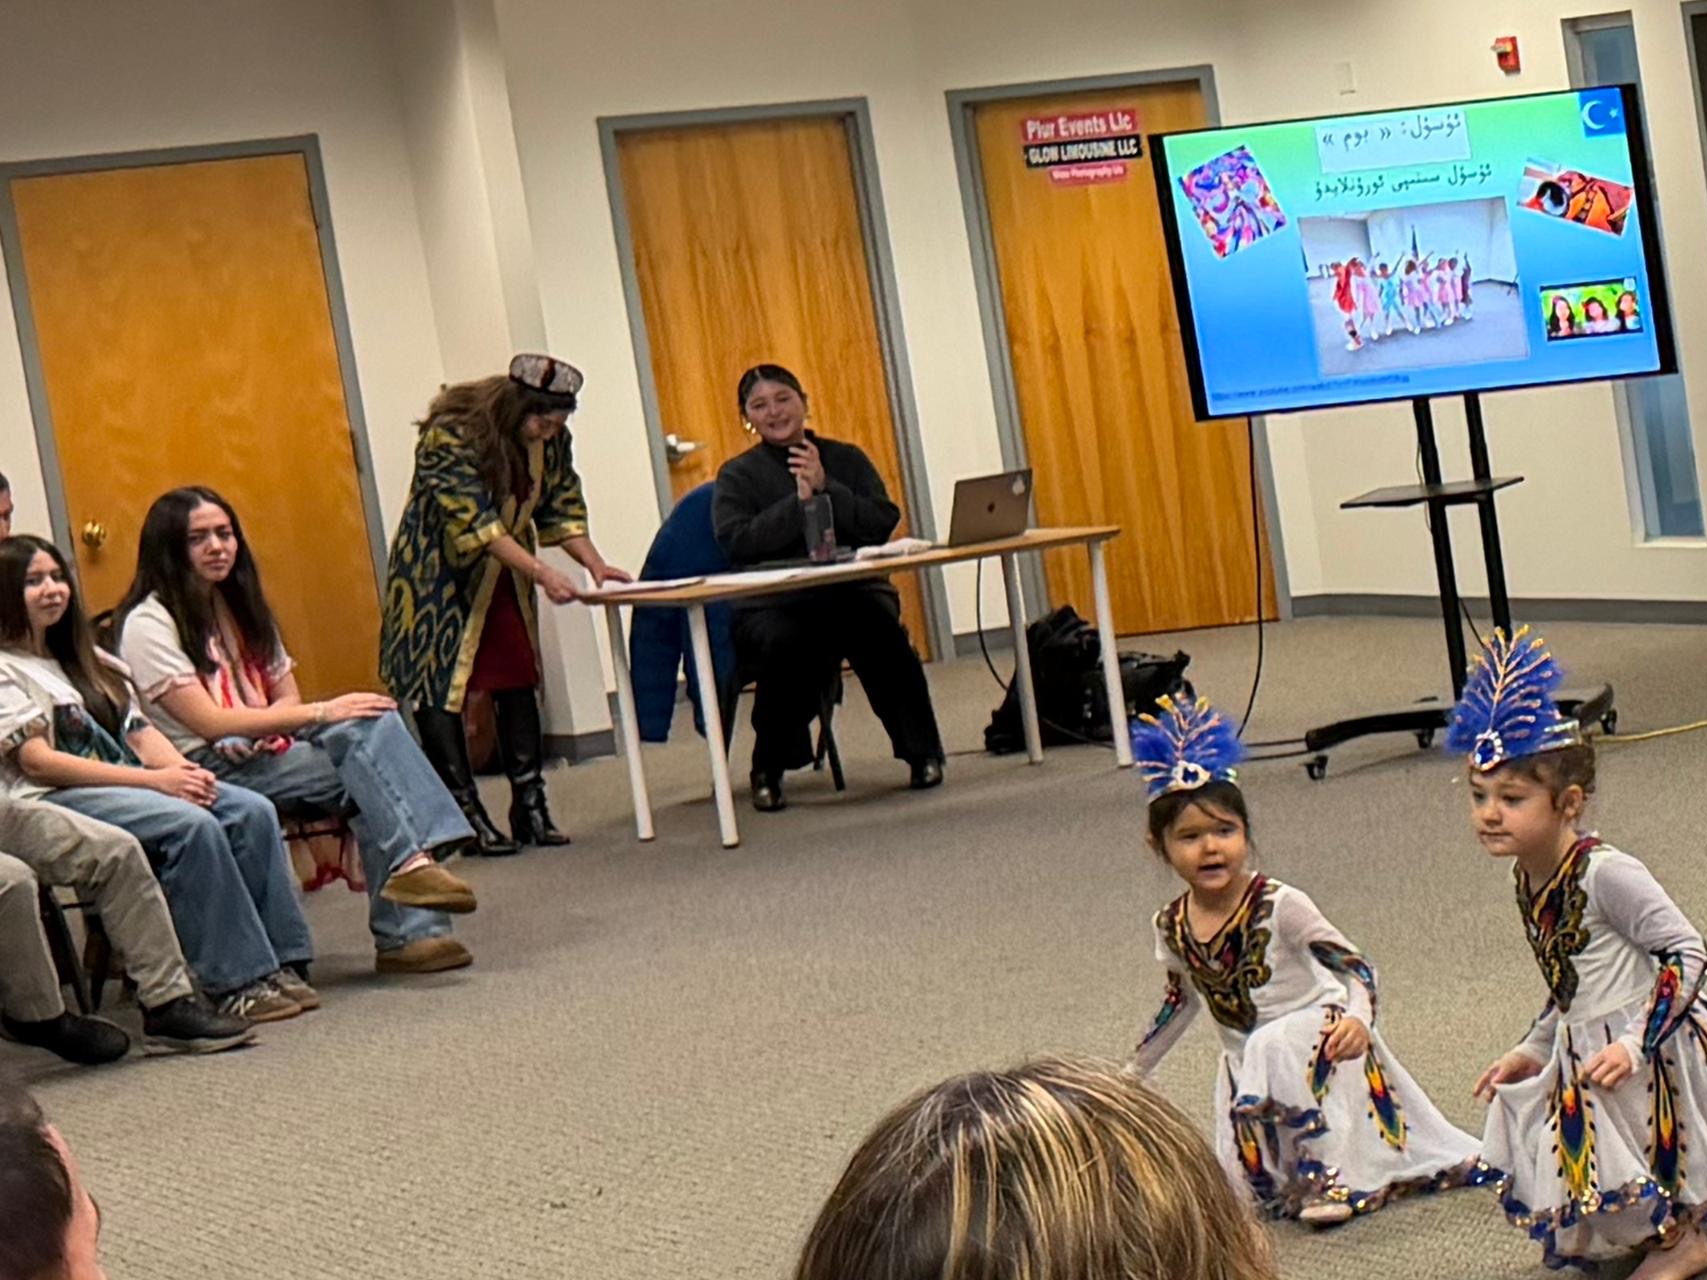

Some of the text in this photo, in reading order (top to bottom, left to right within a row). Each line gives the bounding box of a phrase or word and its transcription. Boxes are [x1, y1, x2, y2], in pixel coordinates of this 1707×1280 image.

[1058, 116, 1107, 136] Events
[1061, 140, 1117, 161] LIMOUSINE
[1118, 138, 1138, 156] LLC
